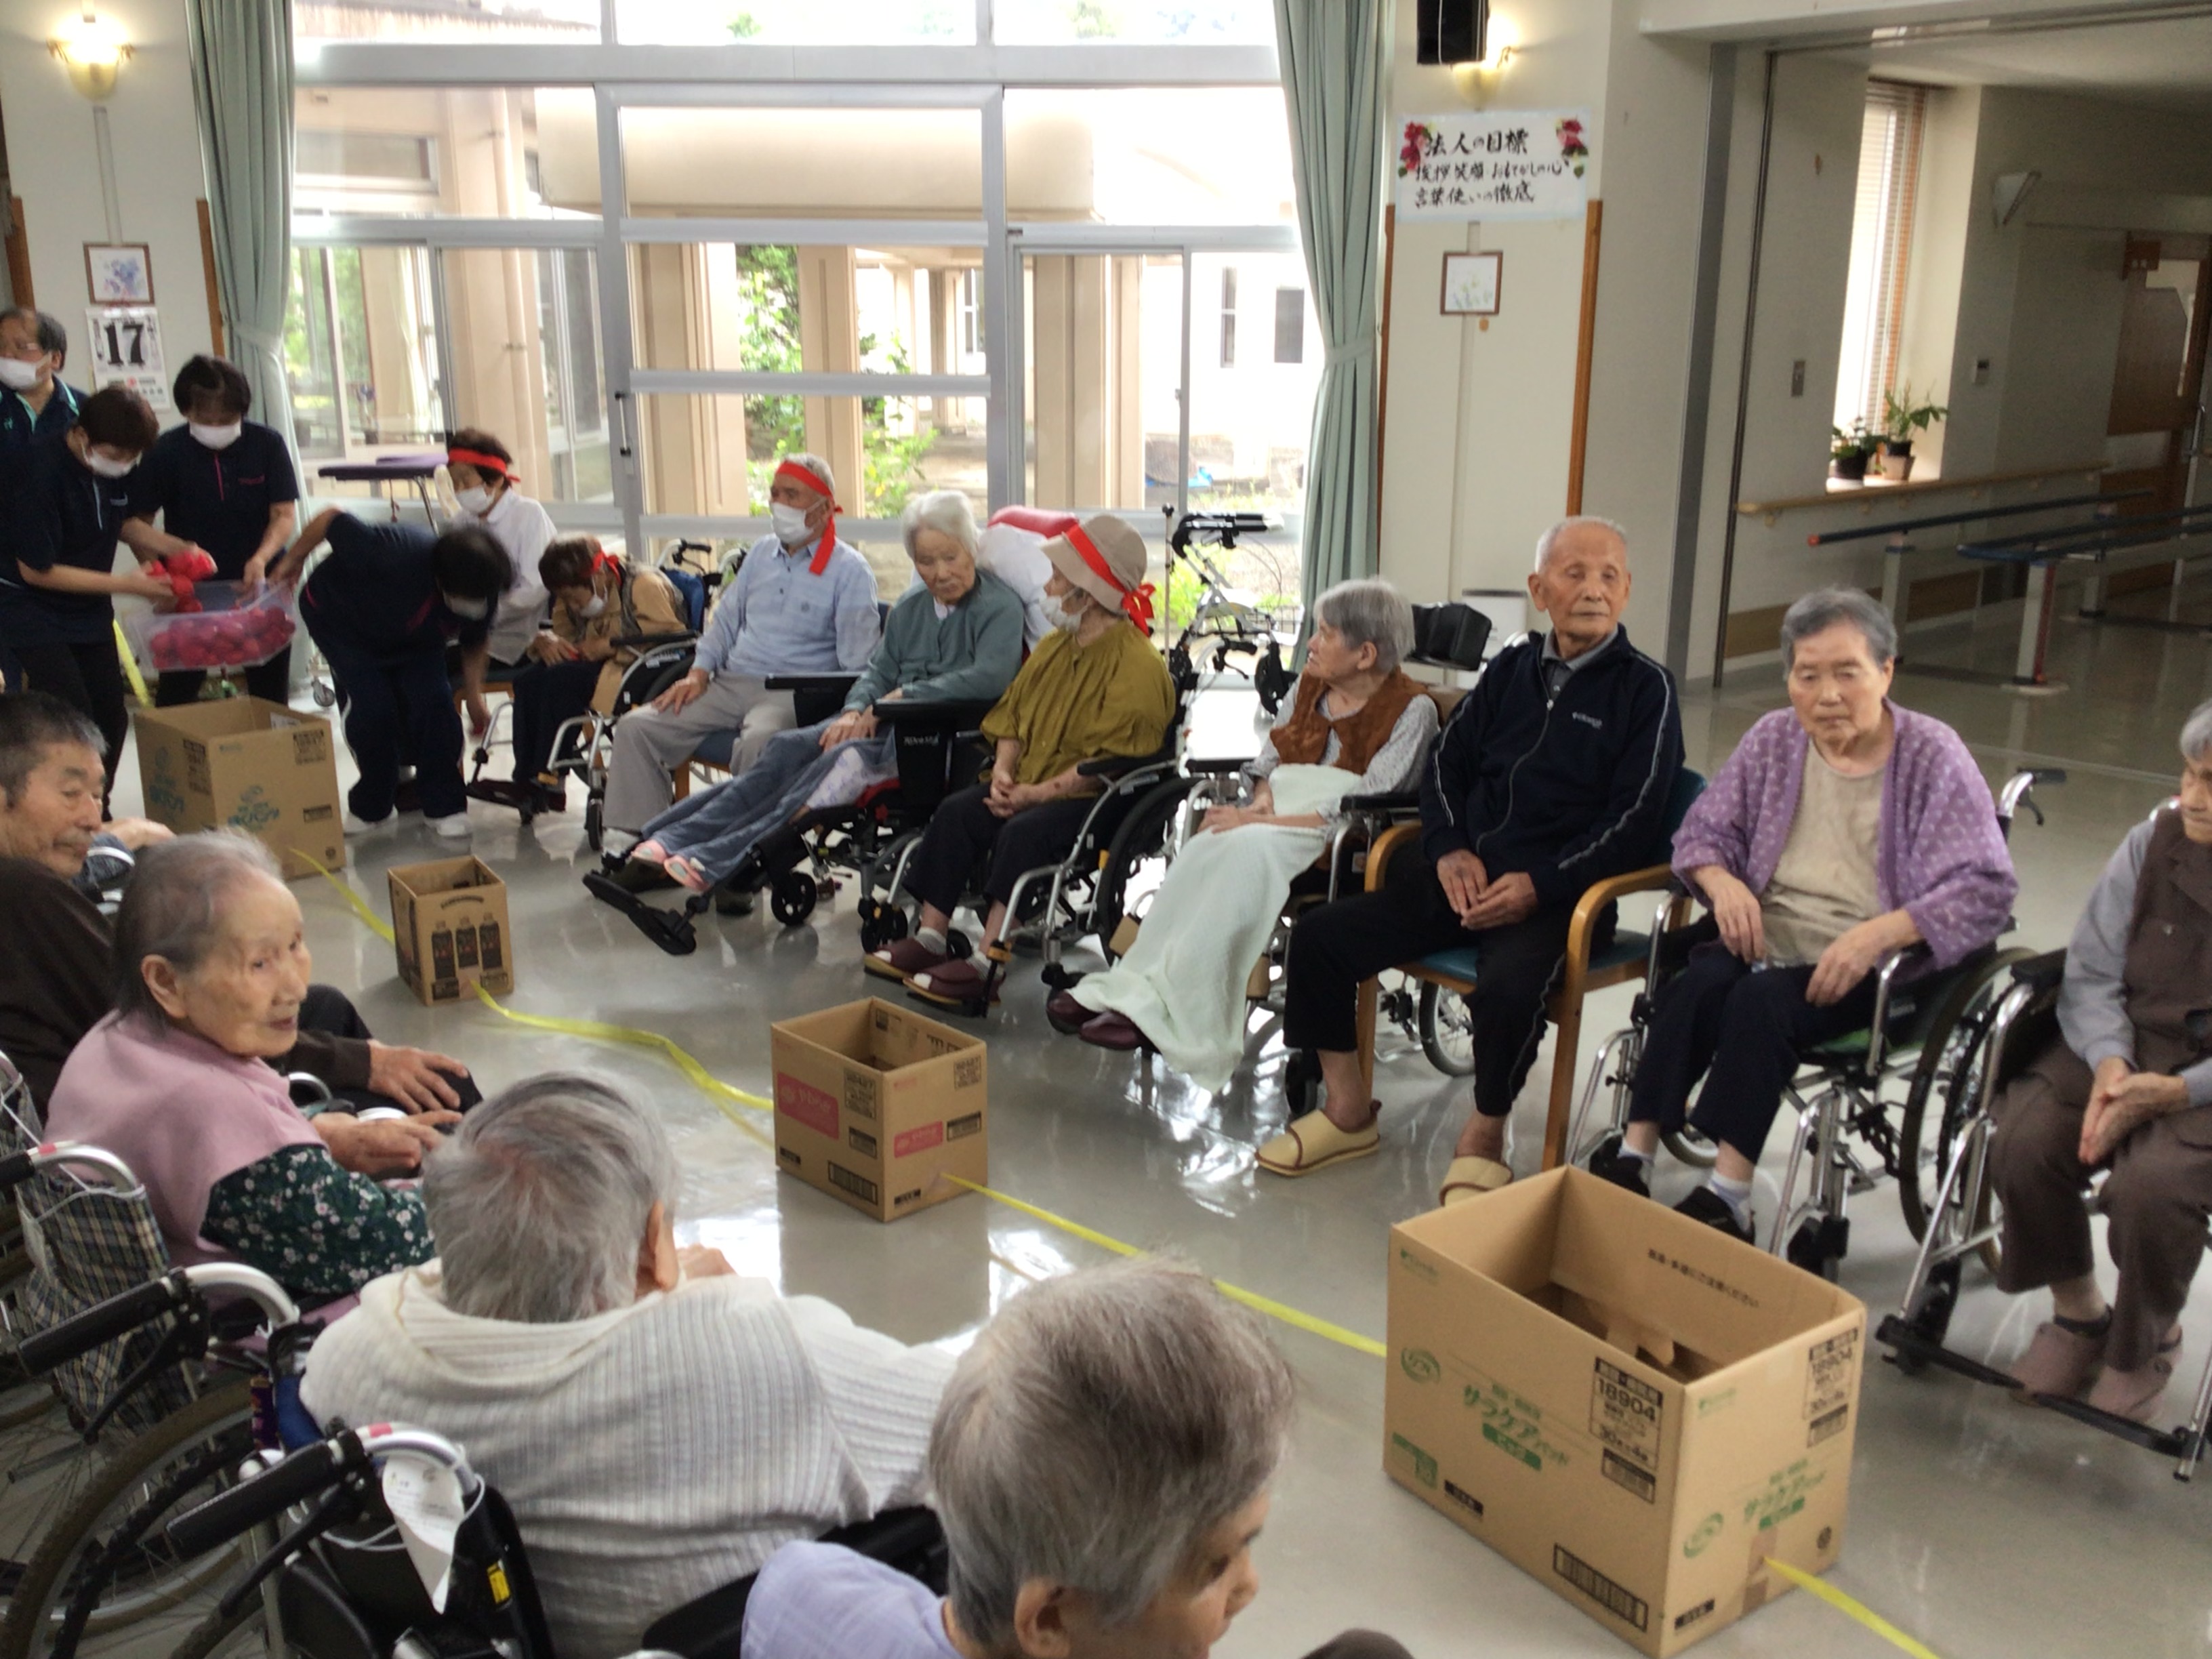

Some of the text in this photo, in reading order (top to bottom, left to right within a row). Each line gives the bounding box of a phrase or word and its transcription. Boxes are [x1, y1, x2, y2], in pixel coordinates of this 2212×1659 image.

[1424, 127, 1529, 157] 法人の目標
[1415, 179, 1536, 209] 言葉使いの徹底
[104, 323, 145, 367] 17
[1598, 1378, 1656, 1422] 18904
